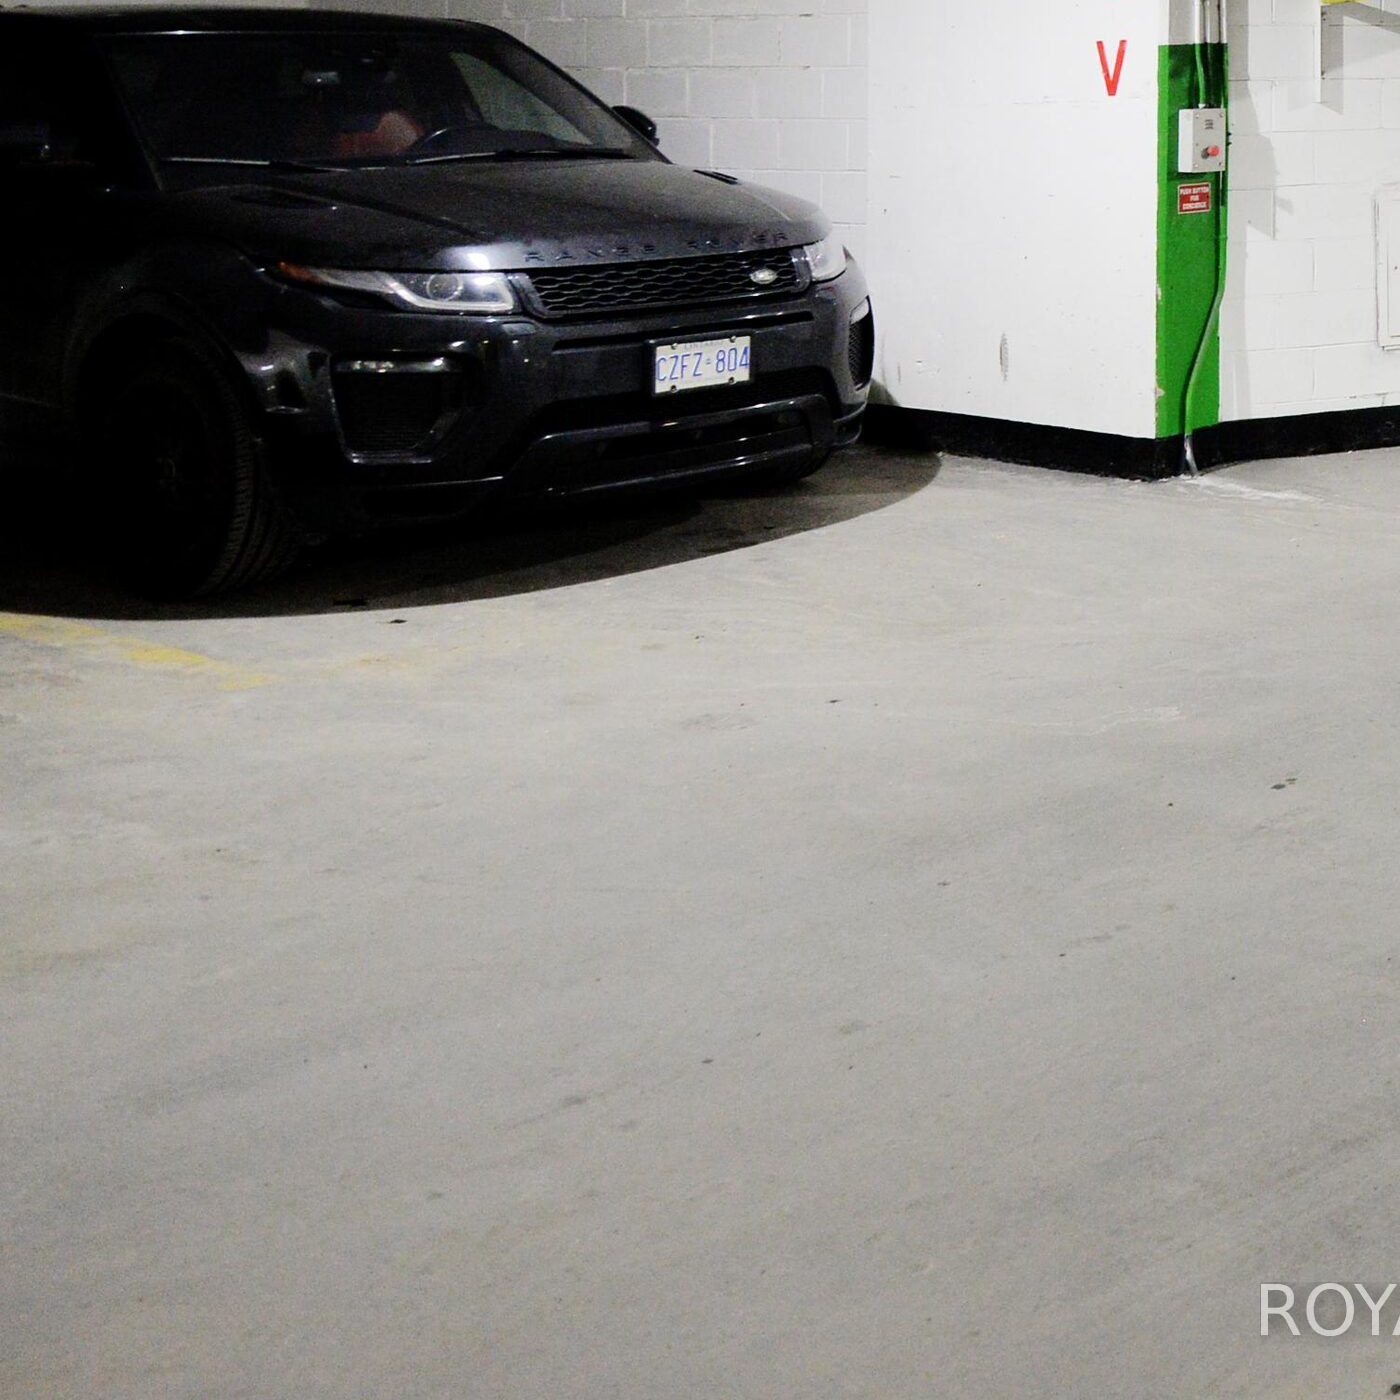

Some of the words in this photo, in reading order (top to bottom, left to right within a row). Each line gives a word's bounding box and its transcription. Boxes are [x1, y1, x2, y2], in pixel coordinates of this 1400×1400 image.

[1096, 39, 1127, 96] V
[656, 352, 703, 381] CZFZ
[715, 346, 749, 373] 804
